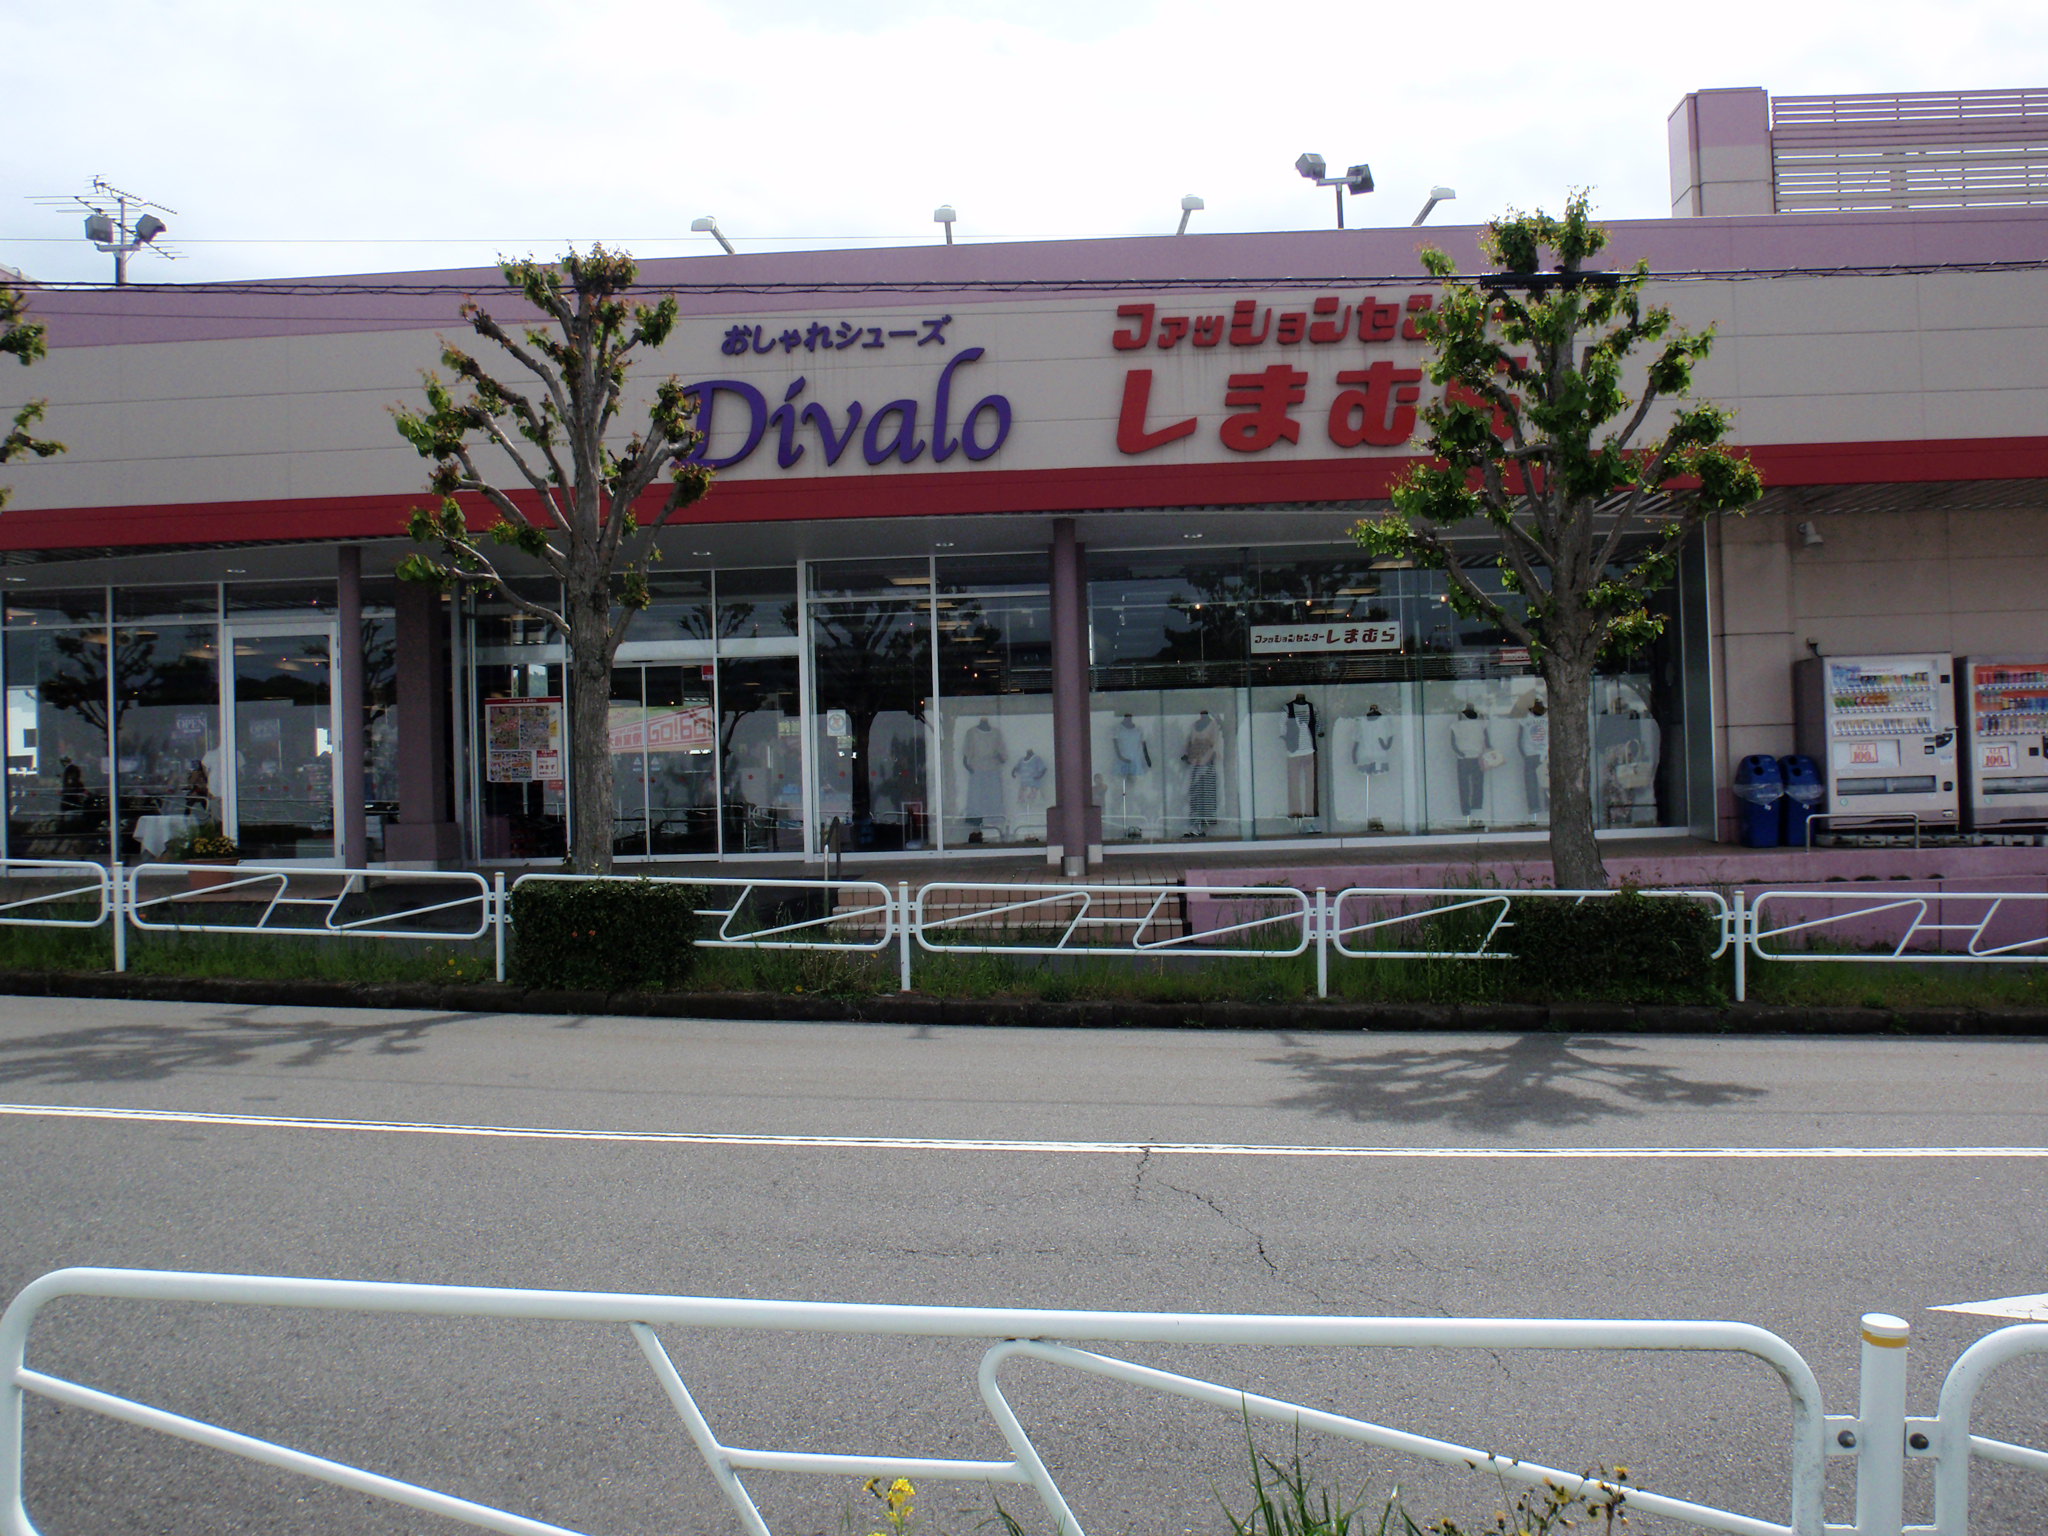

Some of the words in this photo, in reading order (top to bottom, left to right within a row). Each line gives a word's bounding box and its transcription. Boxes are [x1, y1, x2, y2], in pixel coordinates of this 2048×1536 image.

[721, 314, 953, 356] おしゃれシューズ
[1112, 292, 1508, 350] ファッションセン
[668, 347, 1013, 470] Divalo
[176, 719, 206, 729] OPEN
